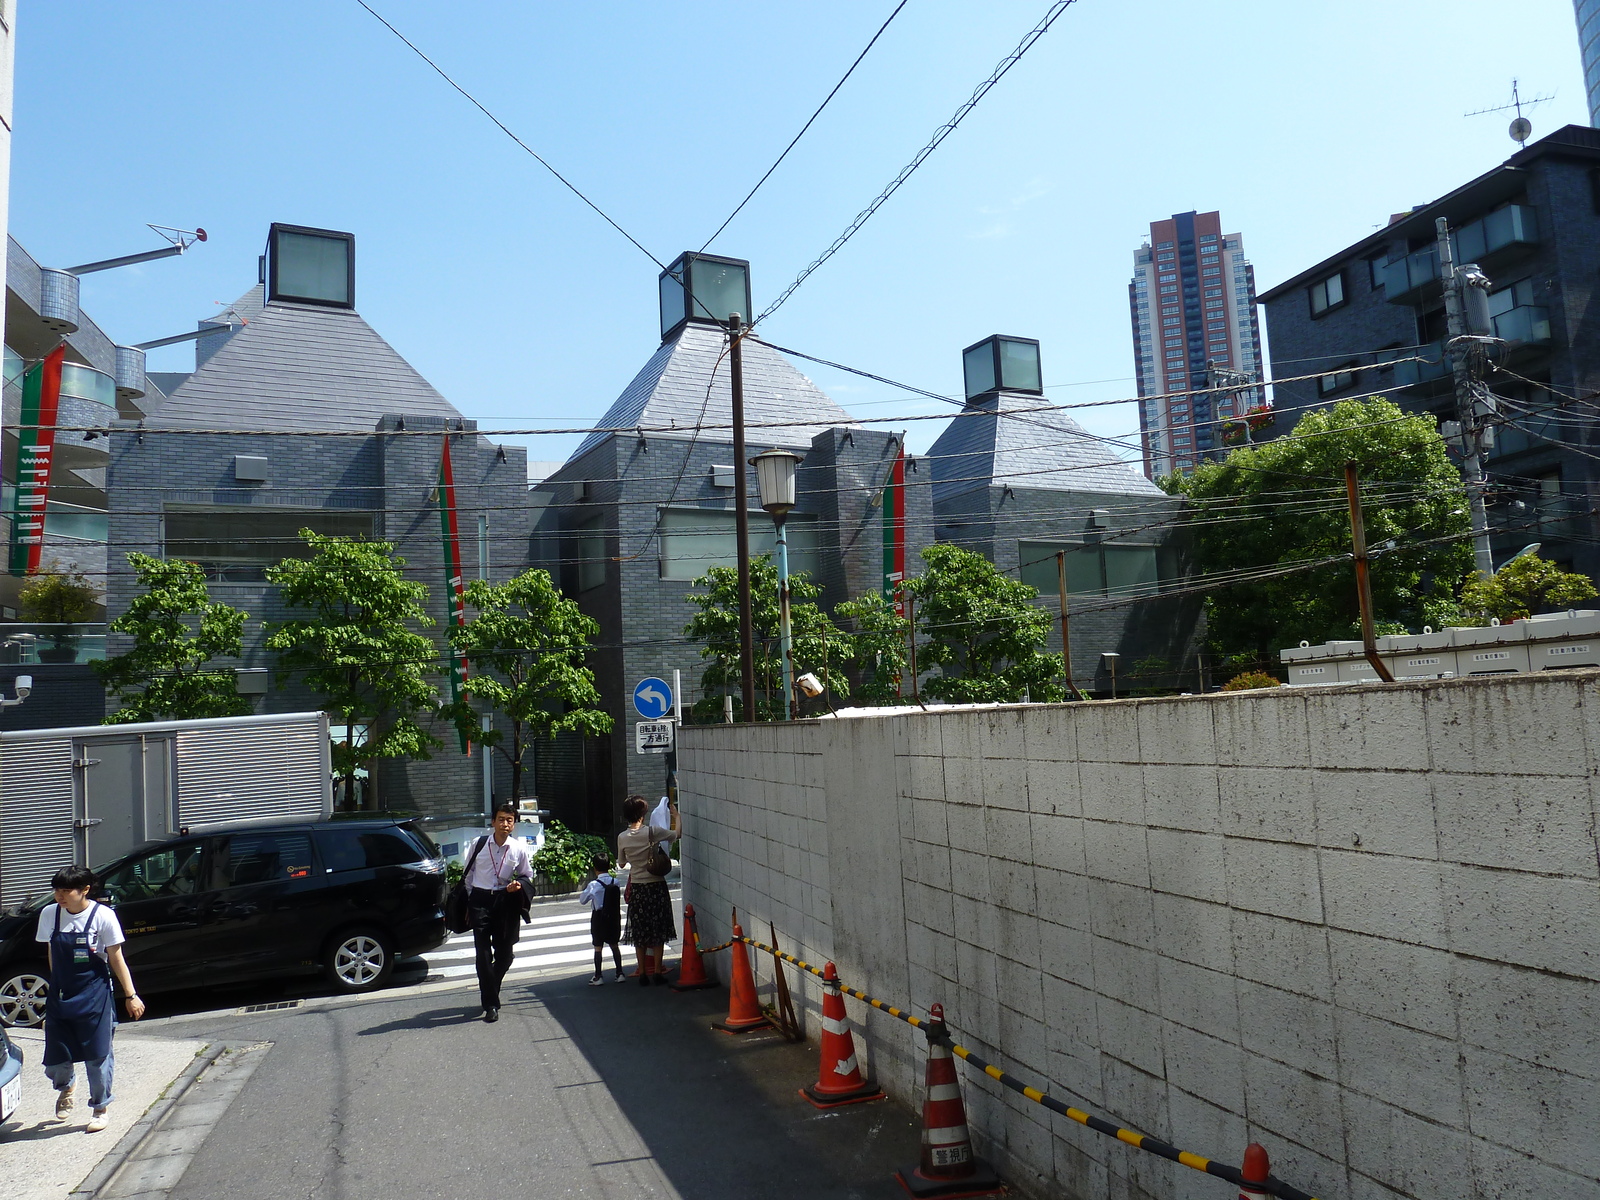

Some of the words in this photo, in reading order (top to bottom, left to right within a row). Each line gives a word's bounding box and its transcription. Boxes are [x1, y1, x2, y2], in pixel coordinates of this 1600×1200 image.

[640, 725, 669, 733] 自転車を除く
[640, 735, 669, 743] 一方通行
[936, 1147, 969, 1164] 警視庁
